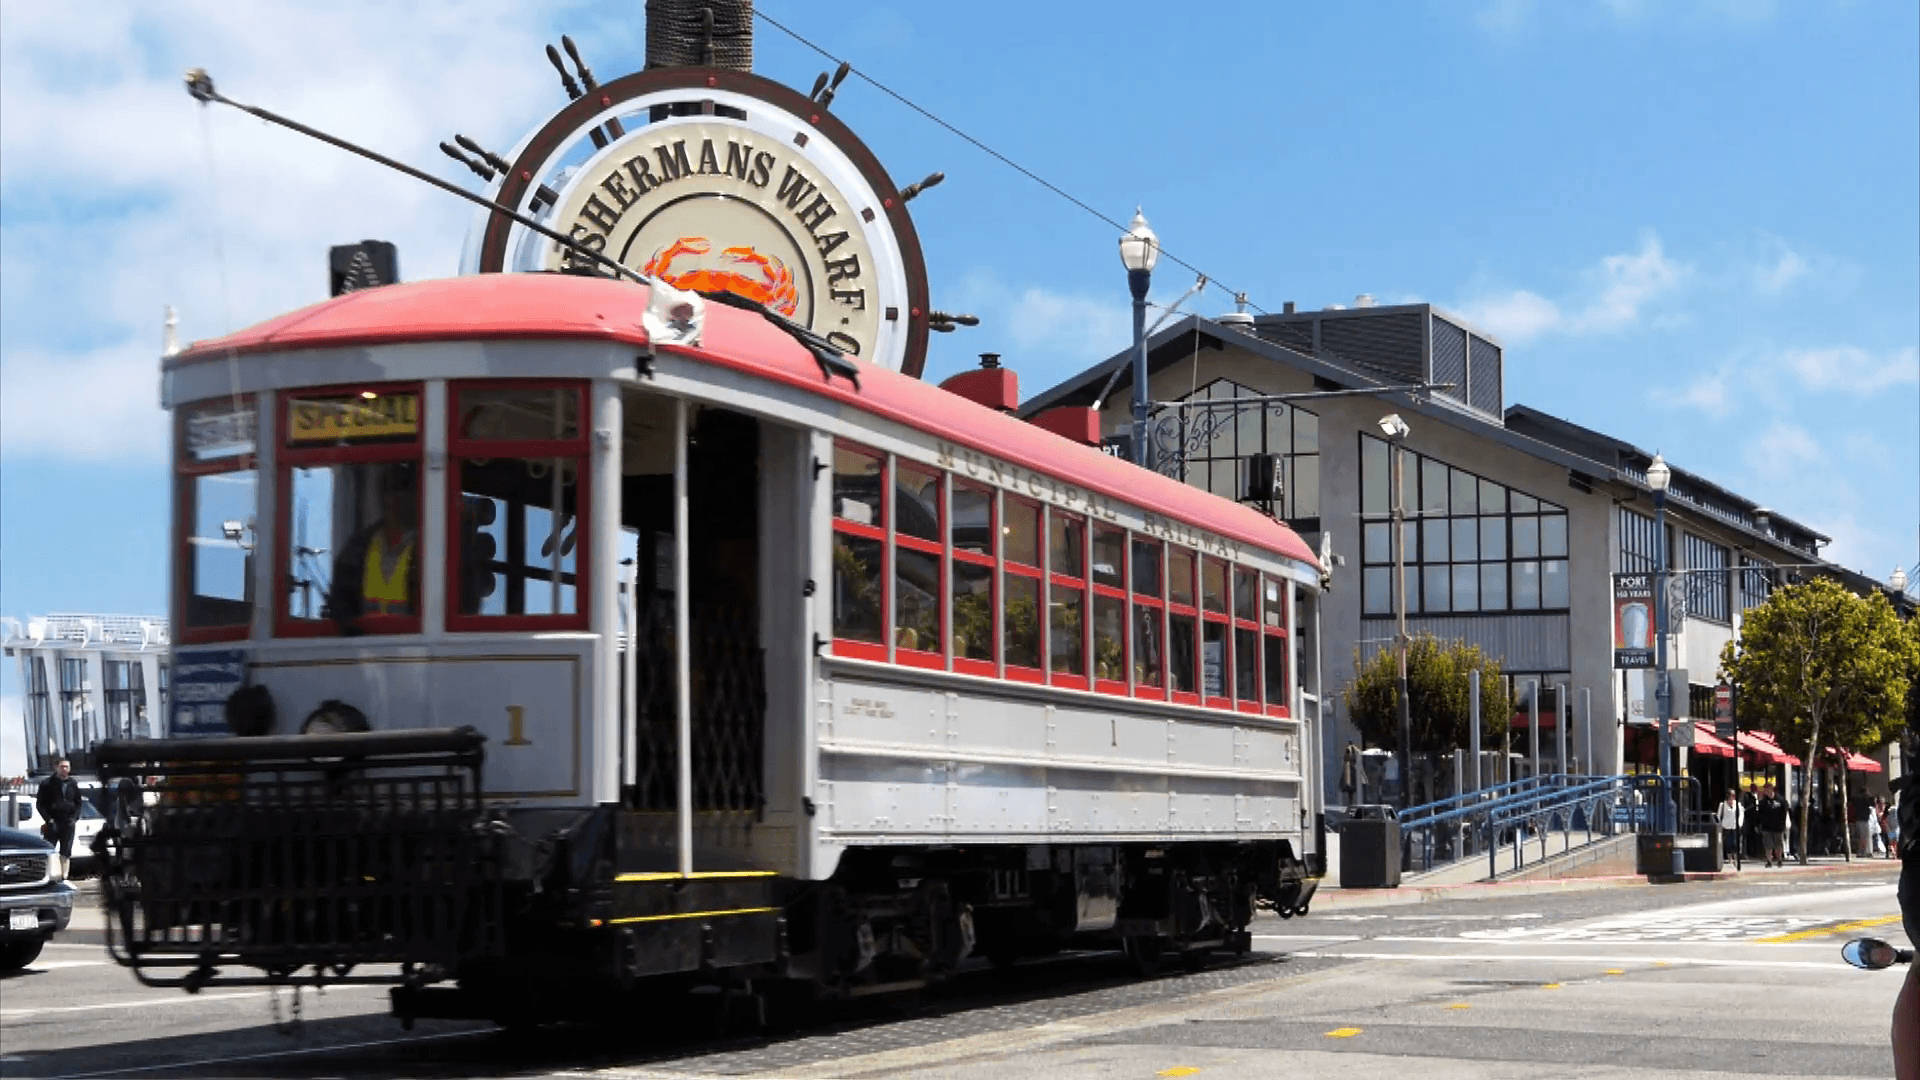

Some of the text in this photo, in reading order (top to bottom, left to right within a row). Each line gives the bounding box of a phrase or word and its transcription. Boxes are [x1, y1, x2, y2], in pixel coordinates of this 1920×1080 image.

[560, 138, 774, 274] ISHERMANS
[776, 164, 866, 311] WHARF
[937, 442, 1242, 560] MUNICIPAL RAILWAY
[1620, 576, 1647, 588] PORT
[1620, 655, 1649, 665] TRAVEL
[502, 704, 532, 746] 1
